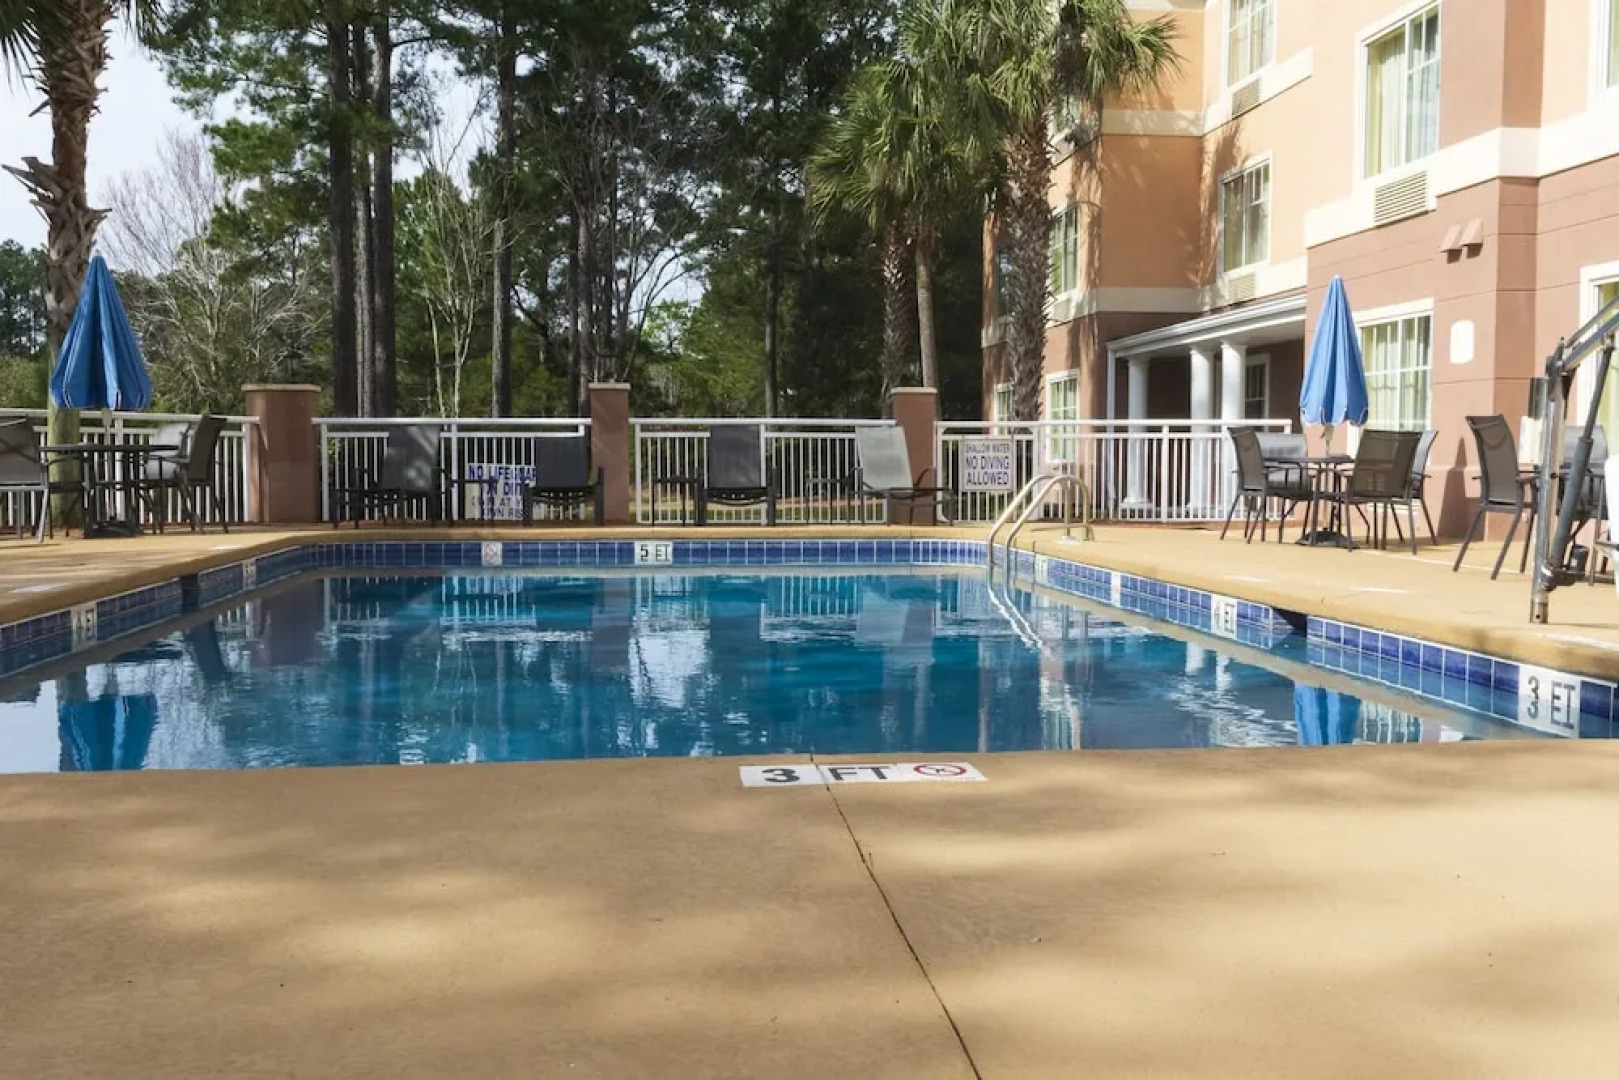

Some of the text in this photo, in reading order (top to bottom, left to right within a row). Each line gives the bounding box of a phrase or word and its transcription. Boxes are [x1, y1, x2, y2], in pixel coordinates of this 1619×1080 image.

[966, 455, 1010, 470] NO DIVING
[469, 465, 483, 480] NO
[966, 471, 1009, 485] ALLOWED
[761, 764, 890, 783] 3 FT
